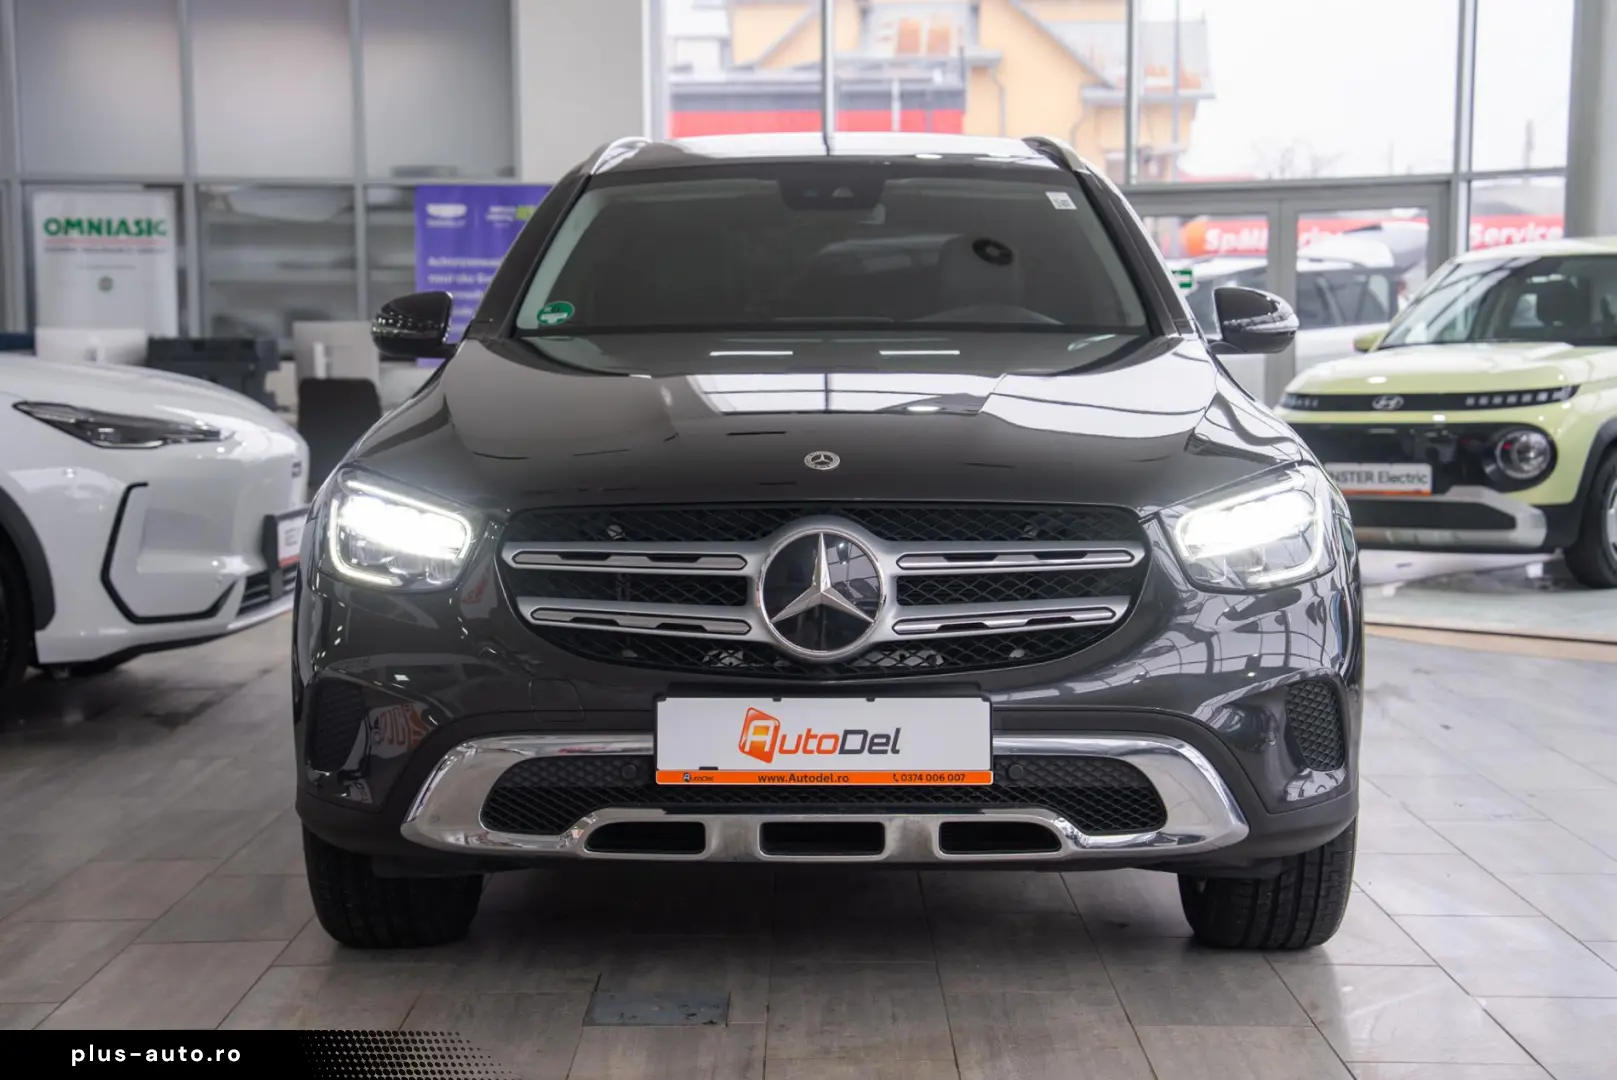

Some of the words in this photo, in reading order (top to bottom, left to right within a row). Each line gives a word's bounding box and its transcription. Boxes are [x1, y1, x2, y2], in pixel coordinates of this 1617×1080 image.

[1328, 470, 1374, 484] NSTER
[1378, 470, 1428, 485] Electric
[741, 717, 902, 756] AutoDel
[758, 773, 849, 783] www.Autodel.ro
[901, 773, 923, 782] 0374
[926, 773, 945, 782] 006
[948, 773, 966, 782] 007
